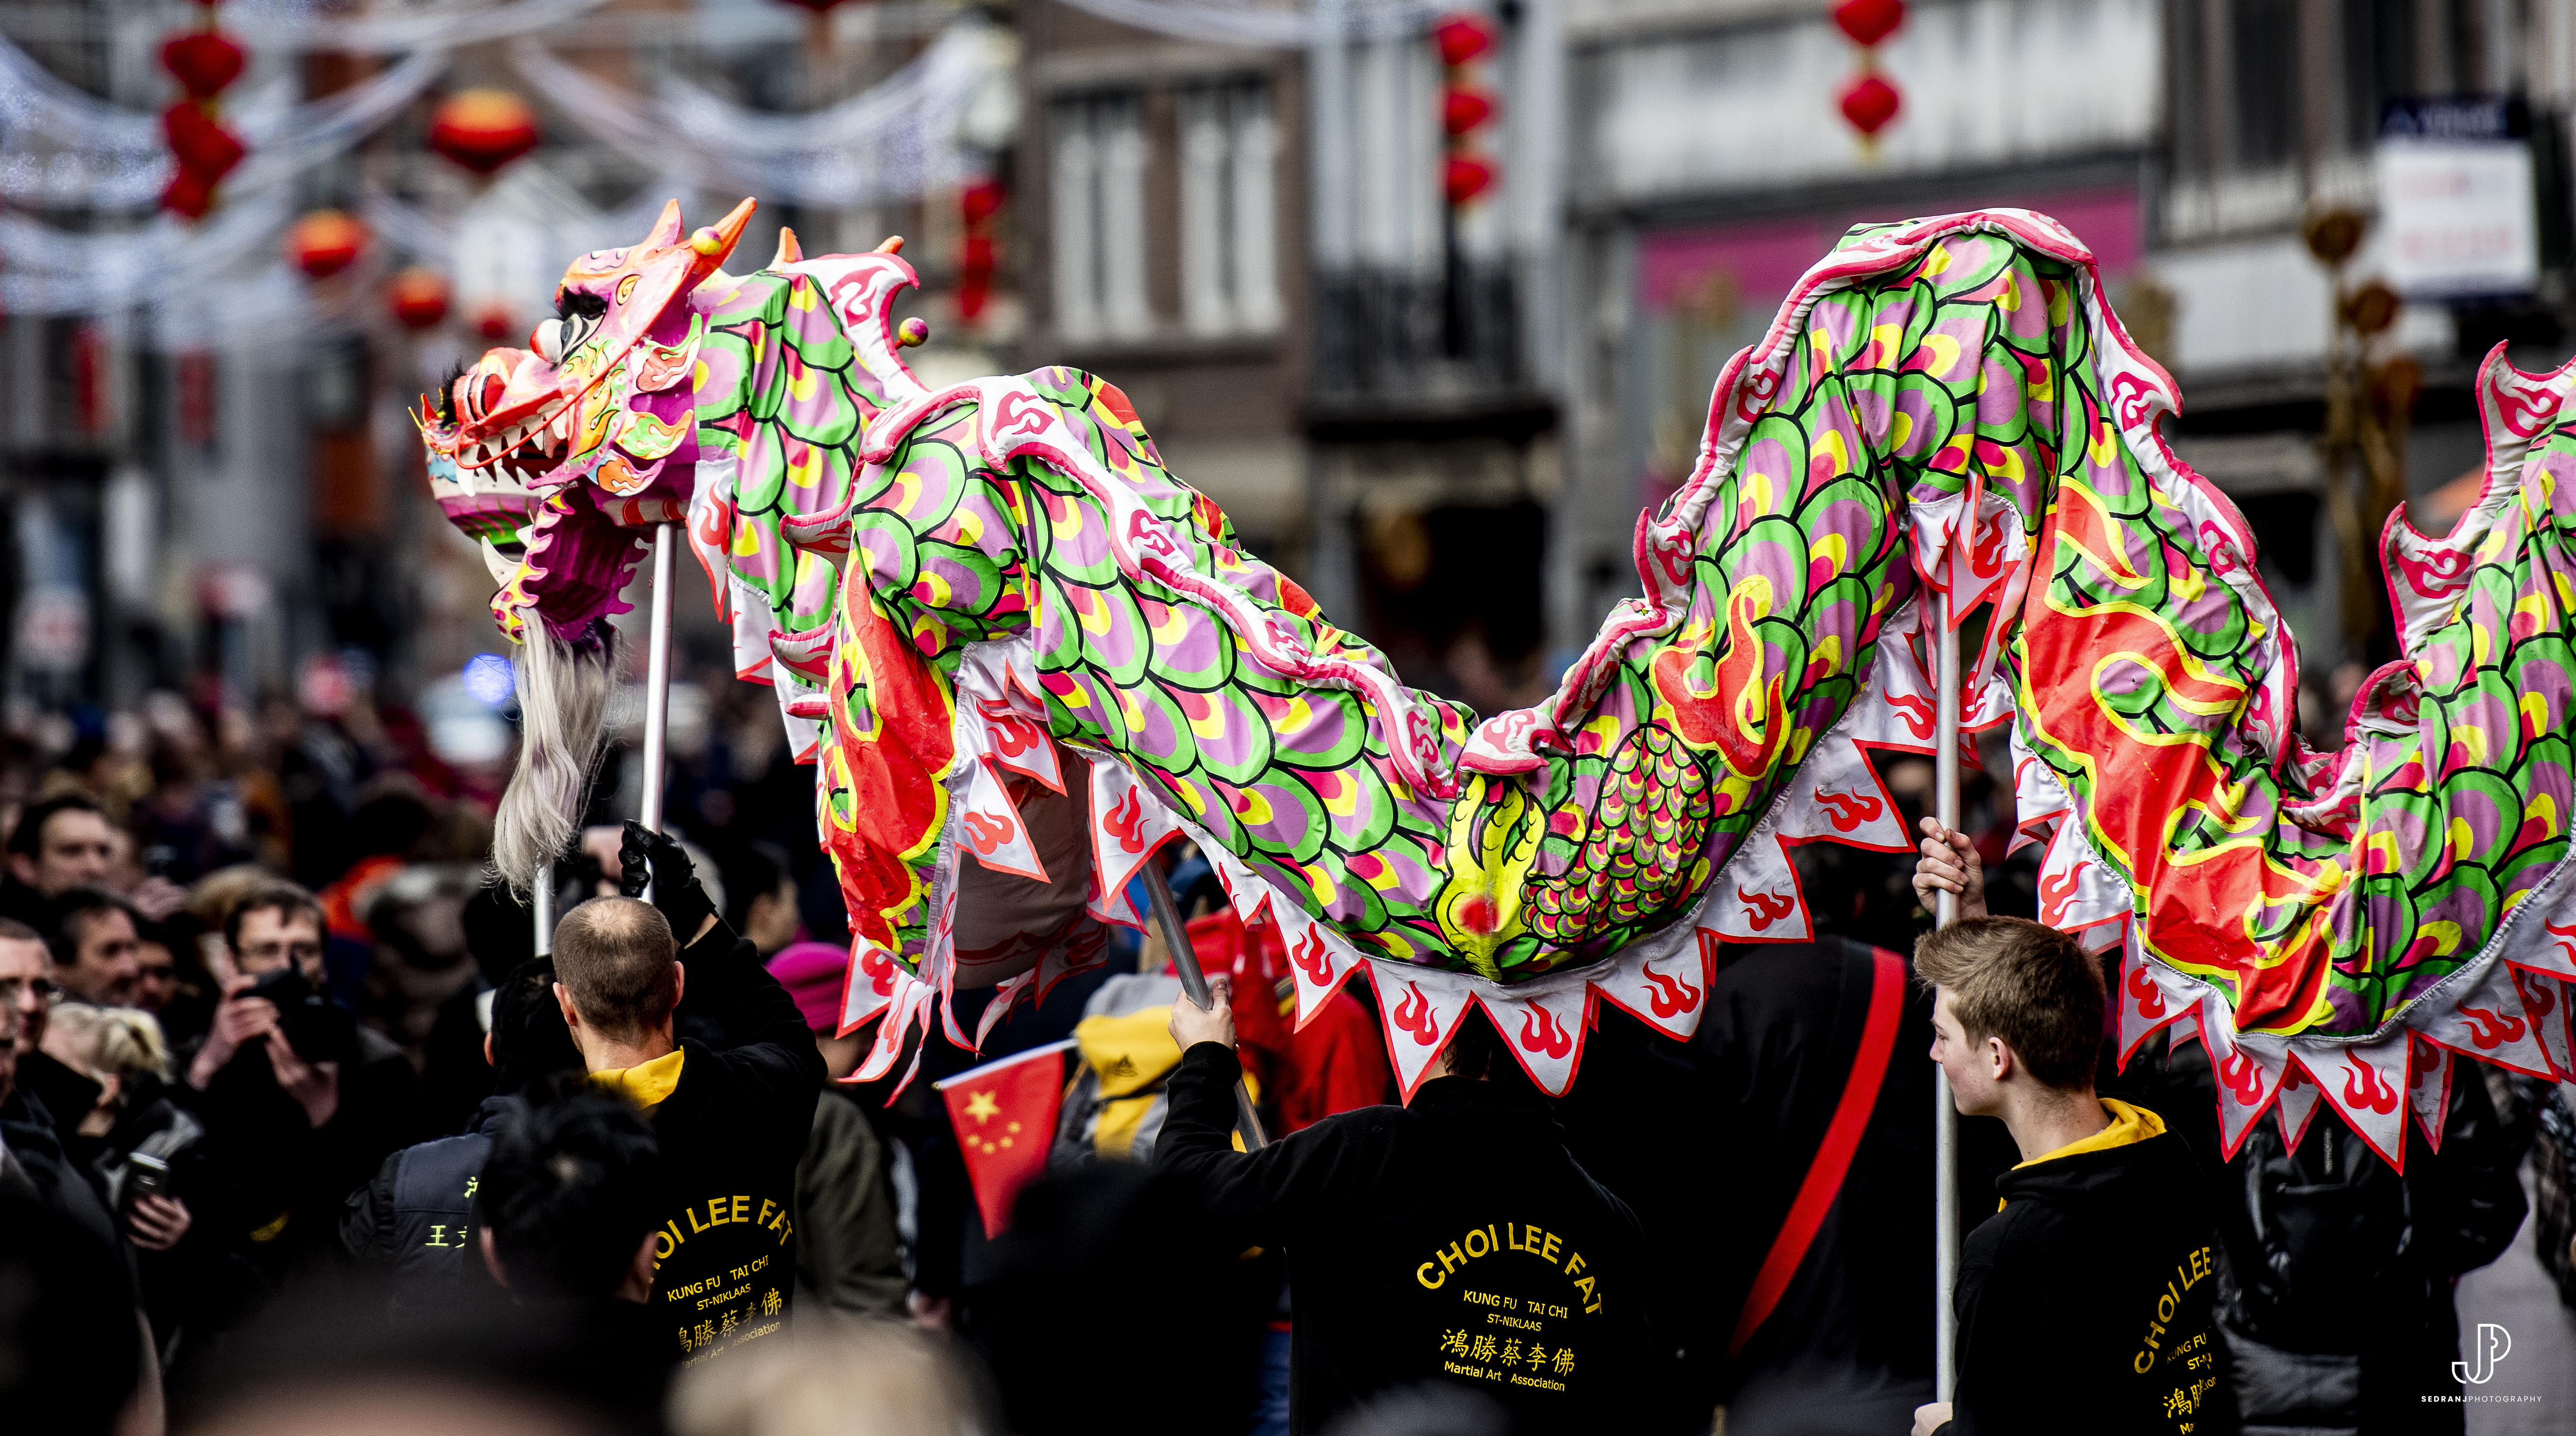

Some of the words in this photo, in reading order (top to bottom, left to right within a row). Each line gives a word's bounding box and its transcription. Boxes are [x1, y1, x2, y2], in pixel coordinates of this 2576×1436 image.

[686, 1196, 750, 1233] LEE
[758, 1199, 792, 1246] FAT
[667, 1283, 703, 1301] KUNG
[706, 1276, 720, 1290] FU
[730, 1265, 749, 1280] TAI
[752, 1255, 768, 1271] CHI
[1417, 1224, 1499, 1289] CHOI
[1508, 1222, 1562, 1264] LEE
[1565, 1252, 1602, 1314] FAT
[697, 1284, 750, 1310] ST-NIKLAAS
[1464, 1290, 1500, 1306] KUNG
[1504, 1297, 1517, 1309] FU
[1528, 1301, 1545, 1314] TAI
[1549, 1305, 1568, 1318] CHI
[2135, 1281, 2180, 1373] CHOI
[2178, 1247, 2211, 1291] LEE
[711, 1346, 724, 1358] Art
[732, 1322, 780, 1348] Association
[1487, 1314, 1542, 1331] ST-NIKLAAS
[1441, 1329, 1575, 1376] 鴻勝蔡李佛
[2167, 1341, 2191, 1364] KUNG
[2193, 1333, 2206, 1348] FU
[1445, 1361, 1483, 1378] Martial
[1486, 1369, 1502, 1381] Art
[1510, 1373, 1564, 1391] Association
